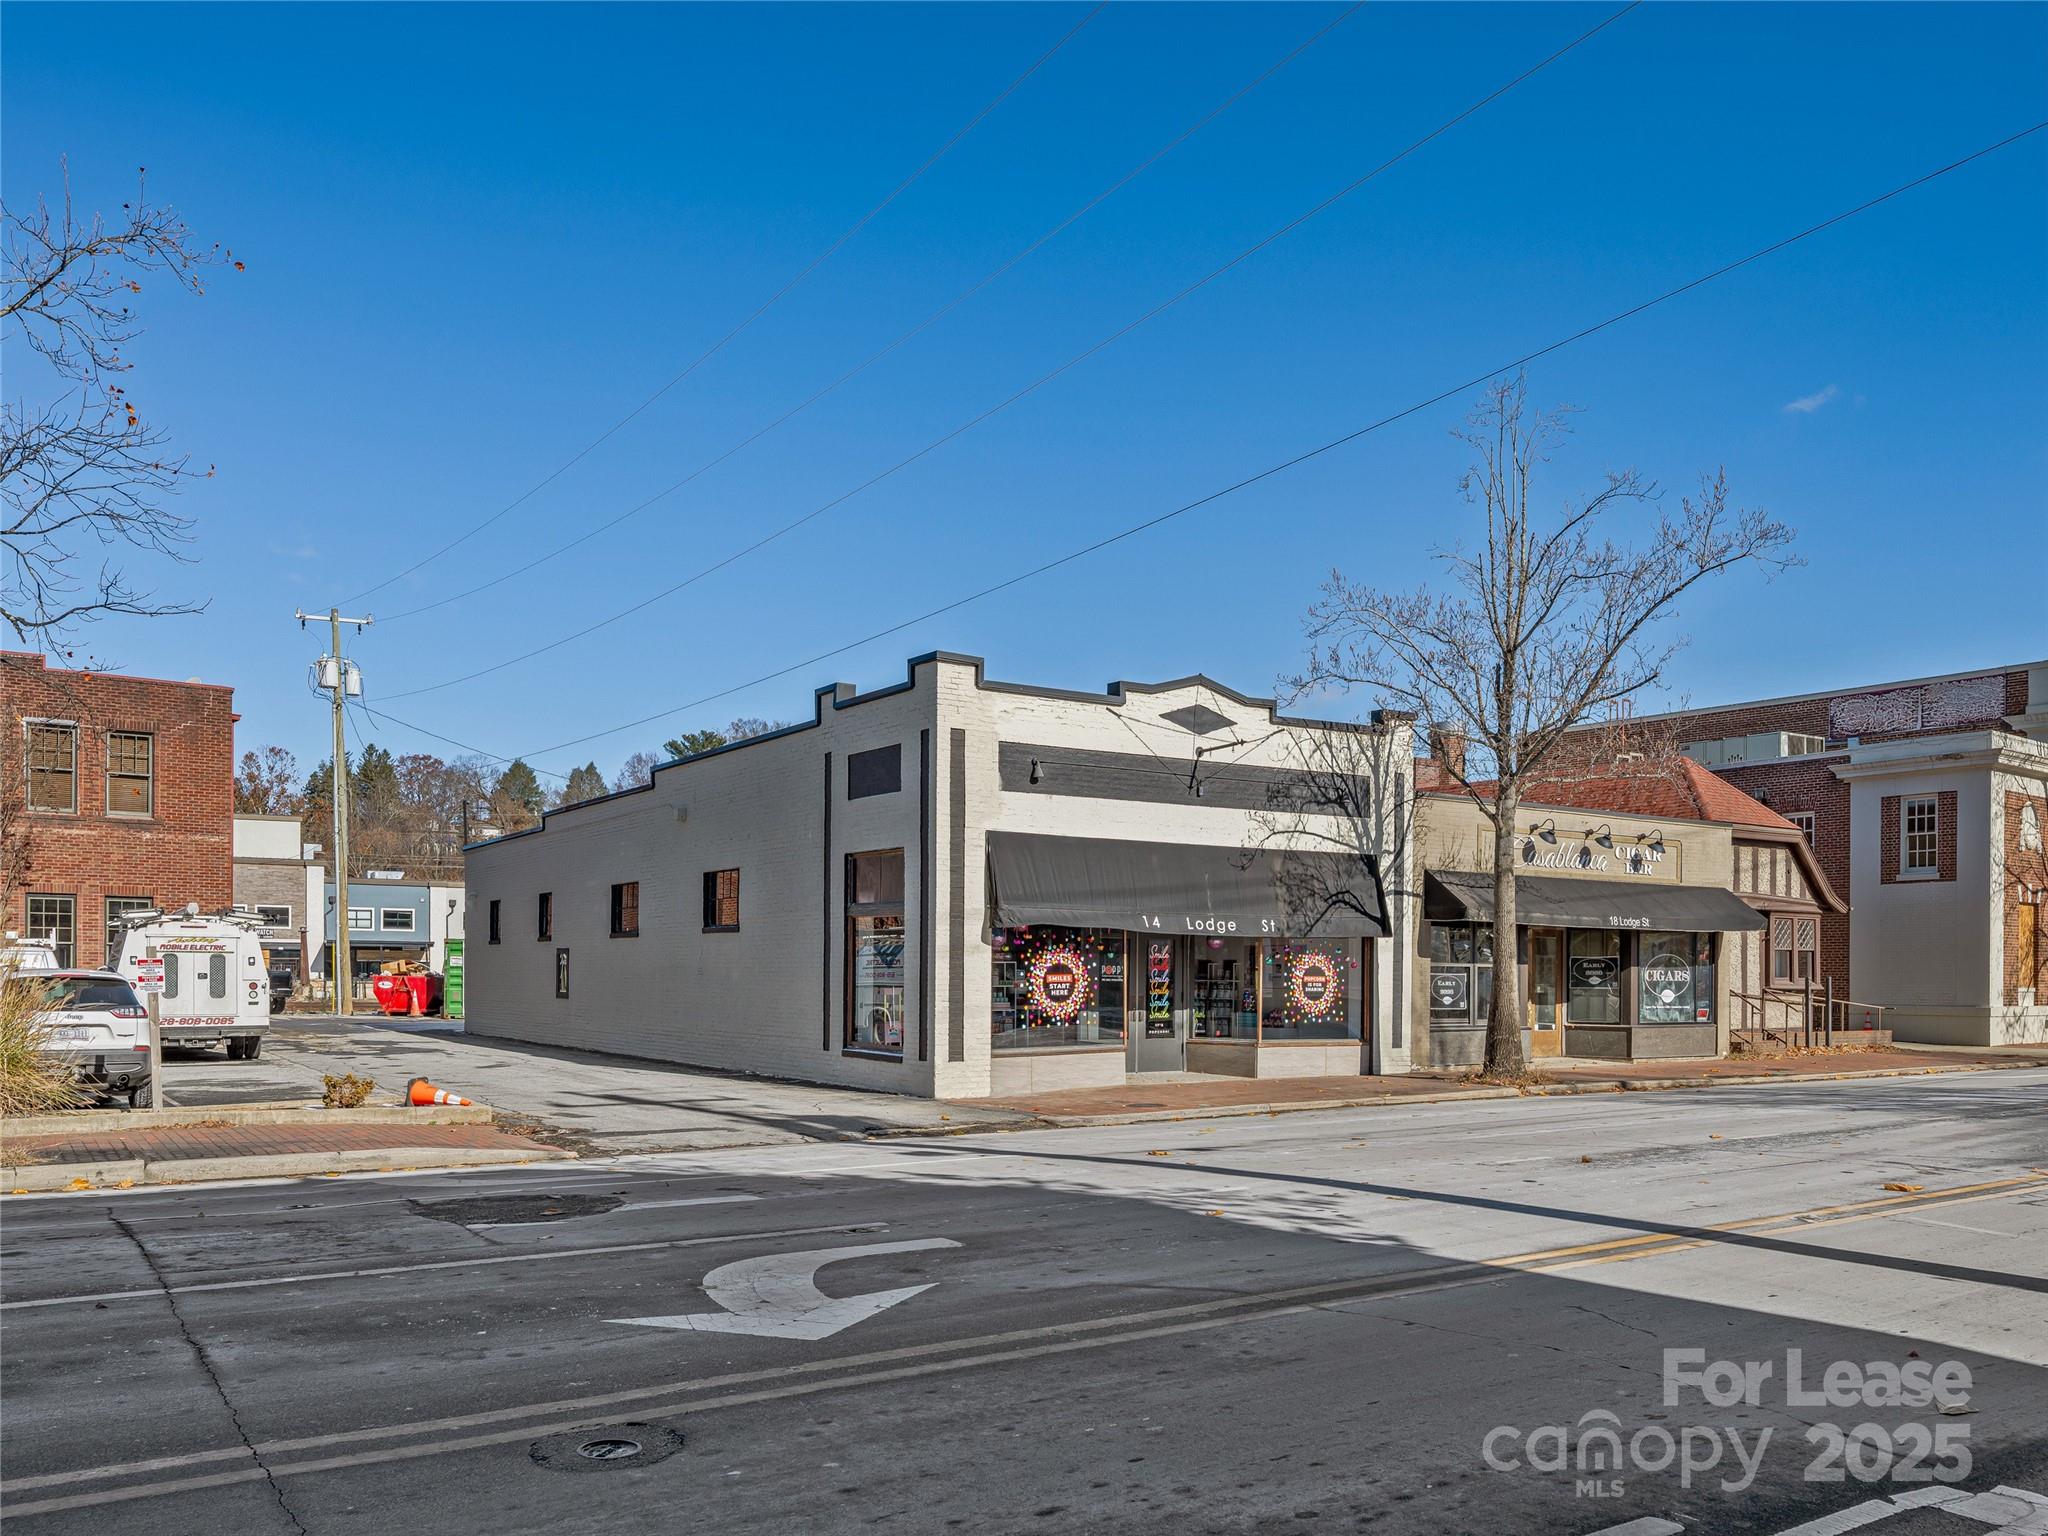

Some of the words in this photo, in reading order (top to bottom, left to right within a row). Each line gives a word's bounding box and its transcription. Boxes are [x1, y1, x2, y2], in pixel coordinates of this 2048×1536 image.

[1614, 845, 1662, 862] CIGAR
[1624, 862, 1653, 876] BAR
[1142, 915, 1160, 929] 14
[1186, 916, 1237, 934] Lodge
[1261, 919, 1276, 933] St
[1609, 916, 1618, 926] 18
[1619, 916, 1641, 929] Lodge
[1641, 917, 1650, 928] St
[159, 943, 189, 951] MOBILE
[1149, 944, 1170, 959] Smile
[1149, 968, 1170, 983] Smile
[1645, 969, 1690, 981] CIGARS
[1149, 991, 1170, 1007] Smile
[1149, 1004, 1170, 1019] Smile
[159, 1016, 235, 1026] 28-808-0085
